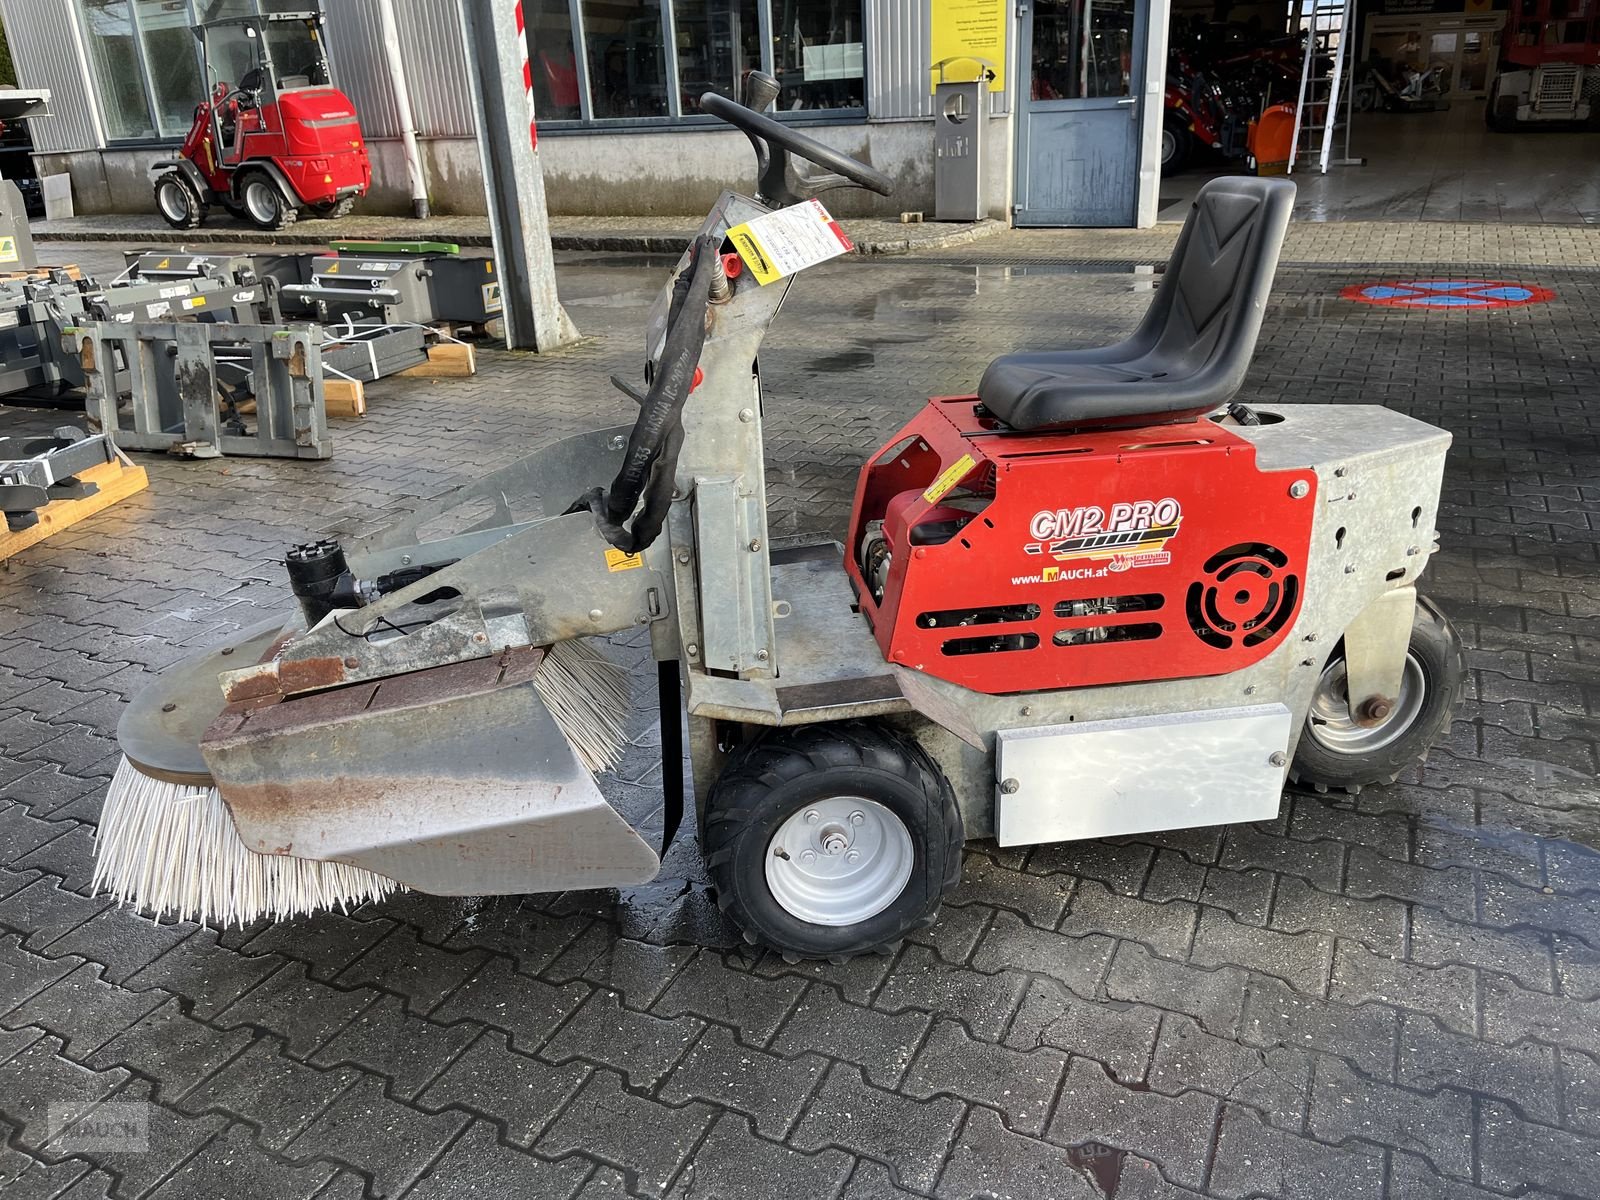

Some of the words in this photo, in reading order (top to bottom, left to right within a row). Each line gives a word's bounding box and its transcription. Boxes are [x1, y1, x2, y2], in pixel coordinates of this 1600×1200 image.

[811, 202, 830, 221] MAUCH
[644, 401, 673, 435] MSHA
[1030, 506, 1105, 541] CM2
[1109, 497, 1181, 532] PRO
[1011, 567, 1108, 585] www.MAUCH.at
